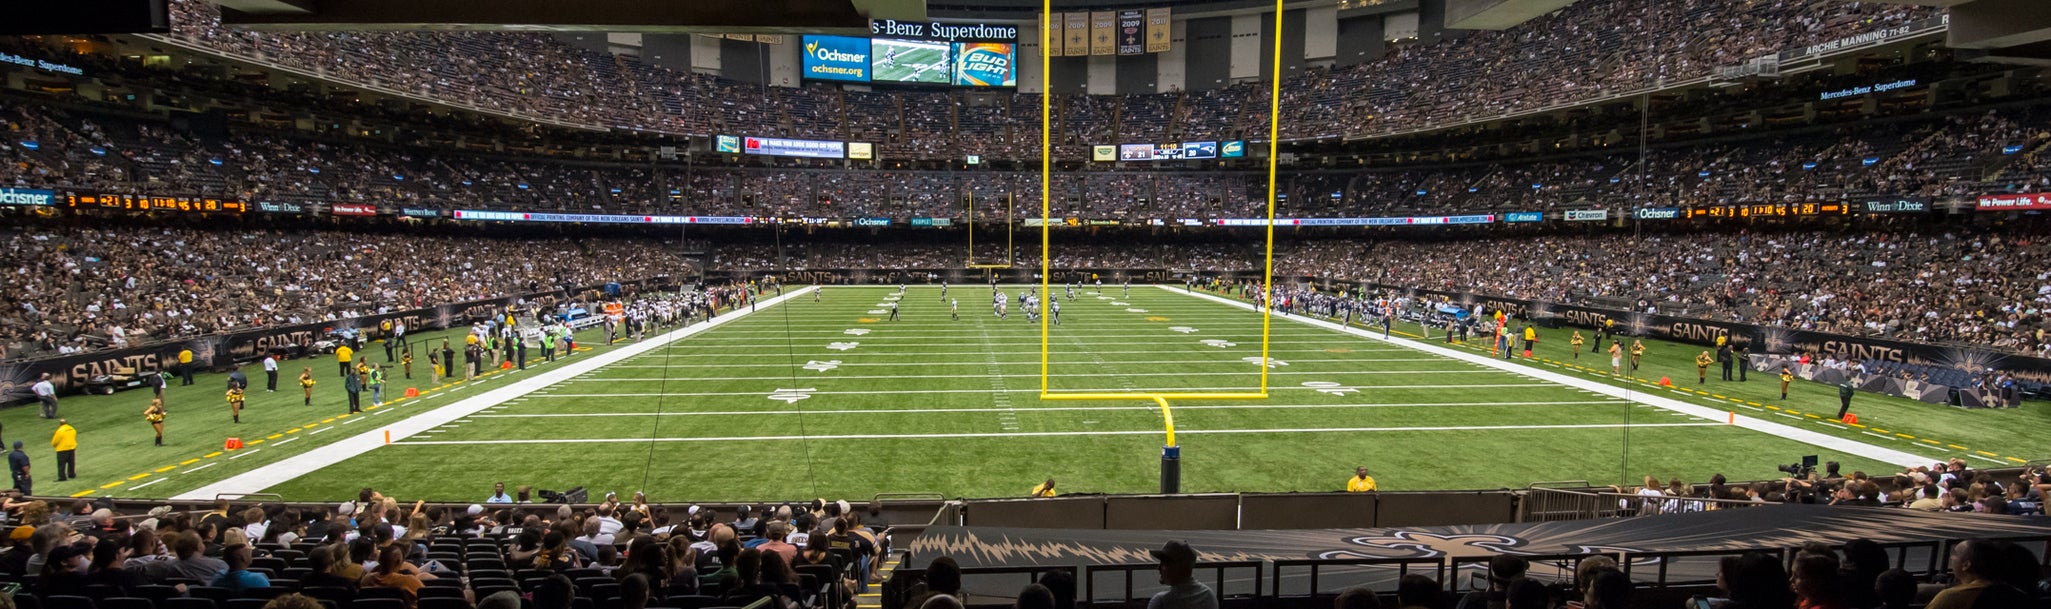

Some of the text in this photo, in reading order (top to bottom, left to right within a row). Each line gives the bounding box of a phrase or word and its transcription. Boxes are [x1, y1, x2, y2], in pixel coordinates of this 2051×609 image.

[1121, 20, 1140, 28] 2009
[931, 22, 1016, 41] Superdome
[1805, 26, 1910, 55] ARCHIE MANNING 71-82
[817, 47, 866, 63] Ochsner
[969, 52, 1009, 66] BUD
[38, 59, 83, 75] Superdome
[811, 64, 863, 78] ochsner.org
[963, 61, 1008, 75] LIGHT
[1820, 79, 1916, 100] Mercedes-Benz Superdome
[69, 196, 76, 207] 3
[107, 196, 119, 206] 21
[125, 198, 132, 209] 3
[140, 199, 149, 210] 10
[178, 201, 190, 211] 45
[205, 200, 216, 210] 20
[1867, 200, 1924, 212] Winn Dixie
[1979, 198, 1991, 207] We
[1991, 197, 2014, 207] Power
[2016, 196, 2033, 206] Life.
[239, 203, 246, 212] 3
[260, 202, 301, 212] Winn Dixie
[1714, 207, 1724, 216] 21
[1729, 208, 1735, 217] 3
[1741, 207, 1749, 217] 10
[1776, 206, 1786, 216] 45
[1792, 206, 1798, 215] 4
[1803, 204, 1814, 214] 20
[1842, 205, 1848, 215] 3
[1578, 211, 1603, 219] Chevron
[1640, 208, 1675, 219] Ochsner
[1686, 209, 1692, 219] 3
[859, 218, 888, 226] Ochsner
[786, 271, 832, 282] SAINTS
[1487, 300, 1518, 316] SAINTS
[1566, 310, 1607, 328] SAINTS
[1672, 322, 1729, 342] SAINTS
[1823, 340, 1903, 363] SAINTS
[72, 353, 158, 388] SAINTS
